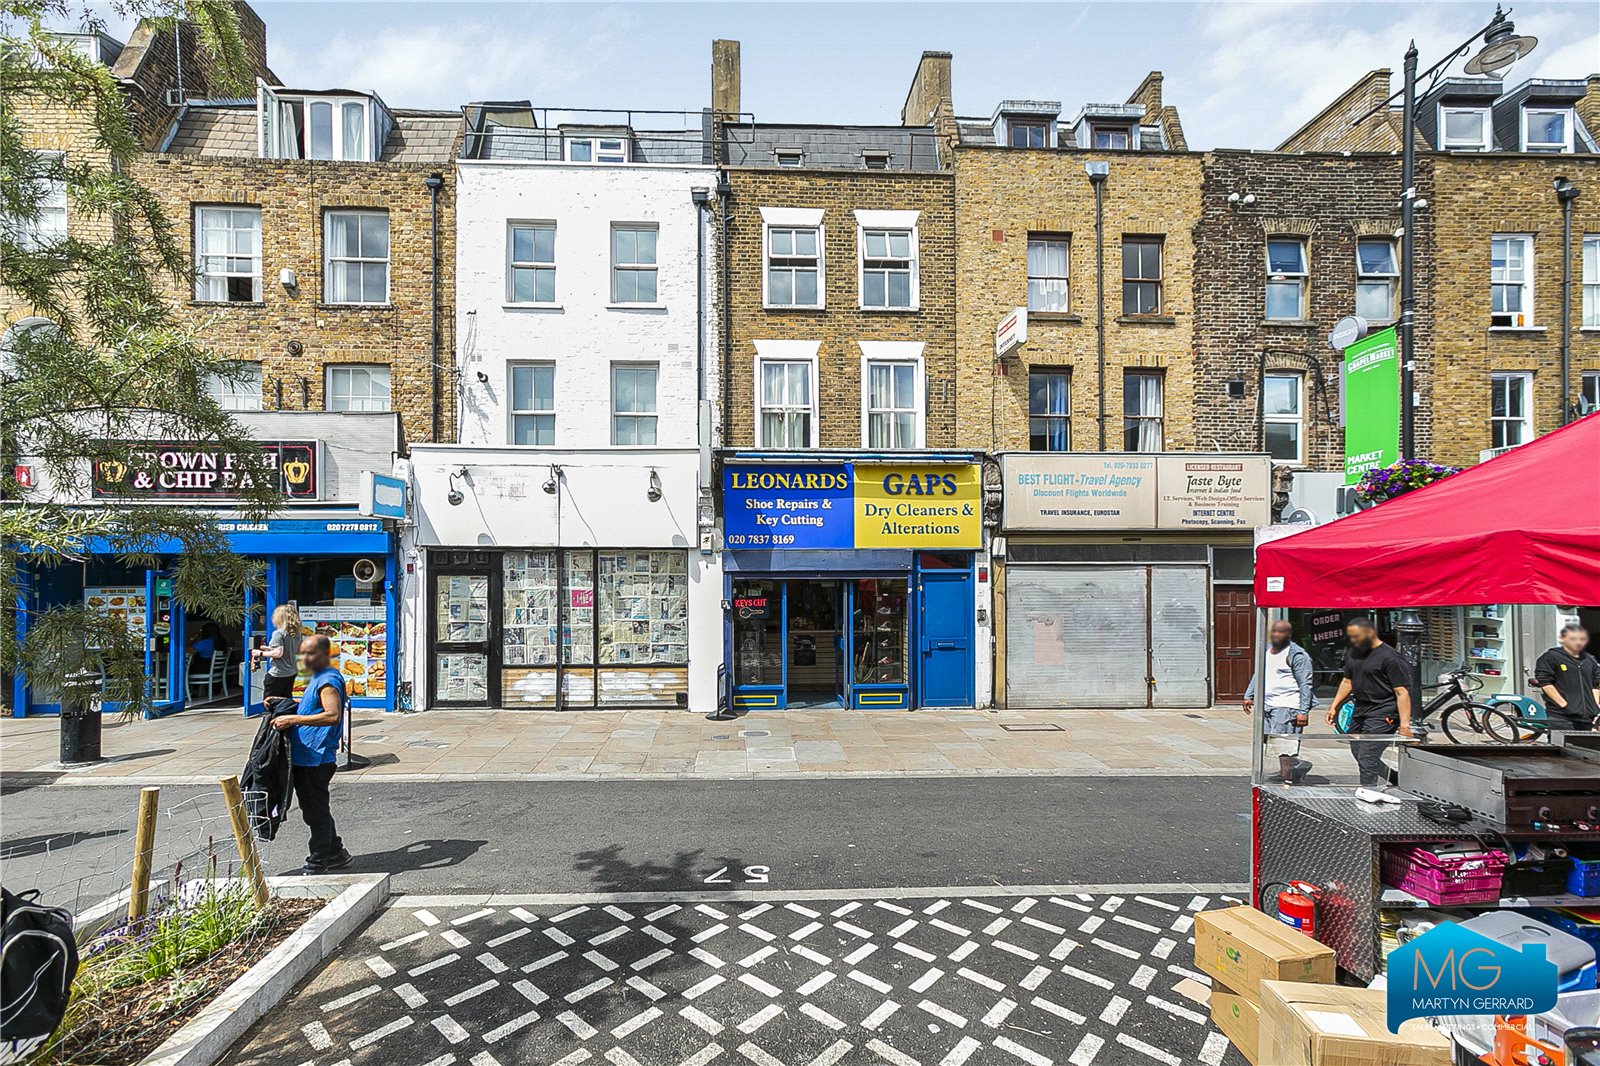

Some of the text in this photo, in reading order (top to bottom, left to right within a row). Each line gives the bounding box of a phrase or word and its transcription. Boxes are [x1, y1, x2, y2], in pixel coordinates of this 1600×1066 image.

[223, 452, 278, 470] FH
[1347, 450, 1384, 465] MARKET
[1186, 463, 1242, 471] LICENSED RESTAURANT
[1347, 461, 1382, 475] CENTRE
[133, 471, 154, 489] &
[159, 471, 218, 489] CHIP
[731, 472, 848, 490] LEONARDS
[883, 473, 958, 496] GAPS
[1018, 474, 1041, 485] BEST
[1109, 474, 1143, 488] Agency
[1186, 475, 1242, 494] Taste Byte
[1033, 489, 1127, 498] Discount Flights Worldwide
[1230, 487, 1242, 495] food
[745, 498, 833, 511] Shoe Repairs &
[864, 503, 974, 519] Dry Cleaners &
[1061, 509, 1093, 517] INSURANCE,
[756, 514, 824, 527] Key Cutting
[881, 522, 960, 534] Alterations
[728, 535, 795, 544] 020 7837 8169
[735, 598, 767, 608] KEYS CUT
[1312, 614, 1340, 626] ORDER
[1318, 629, 1339, 641] HERE
